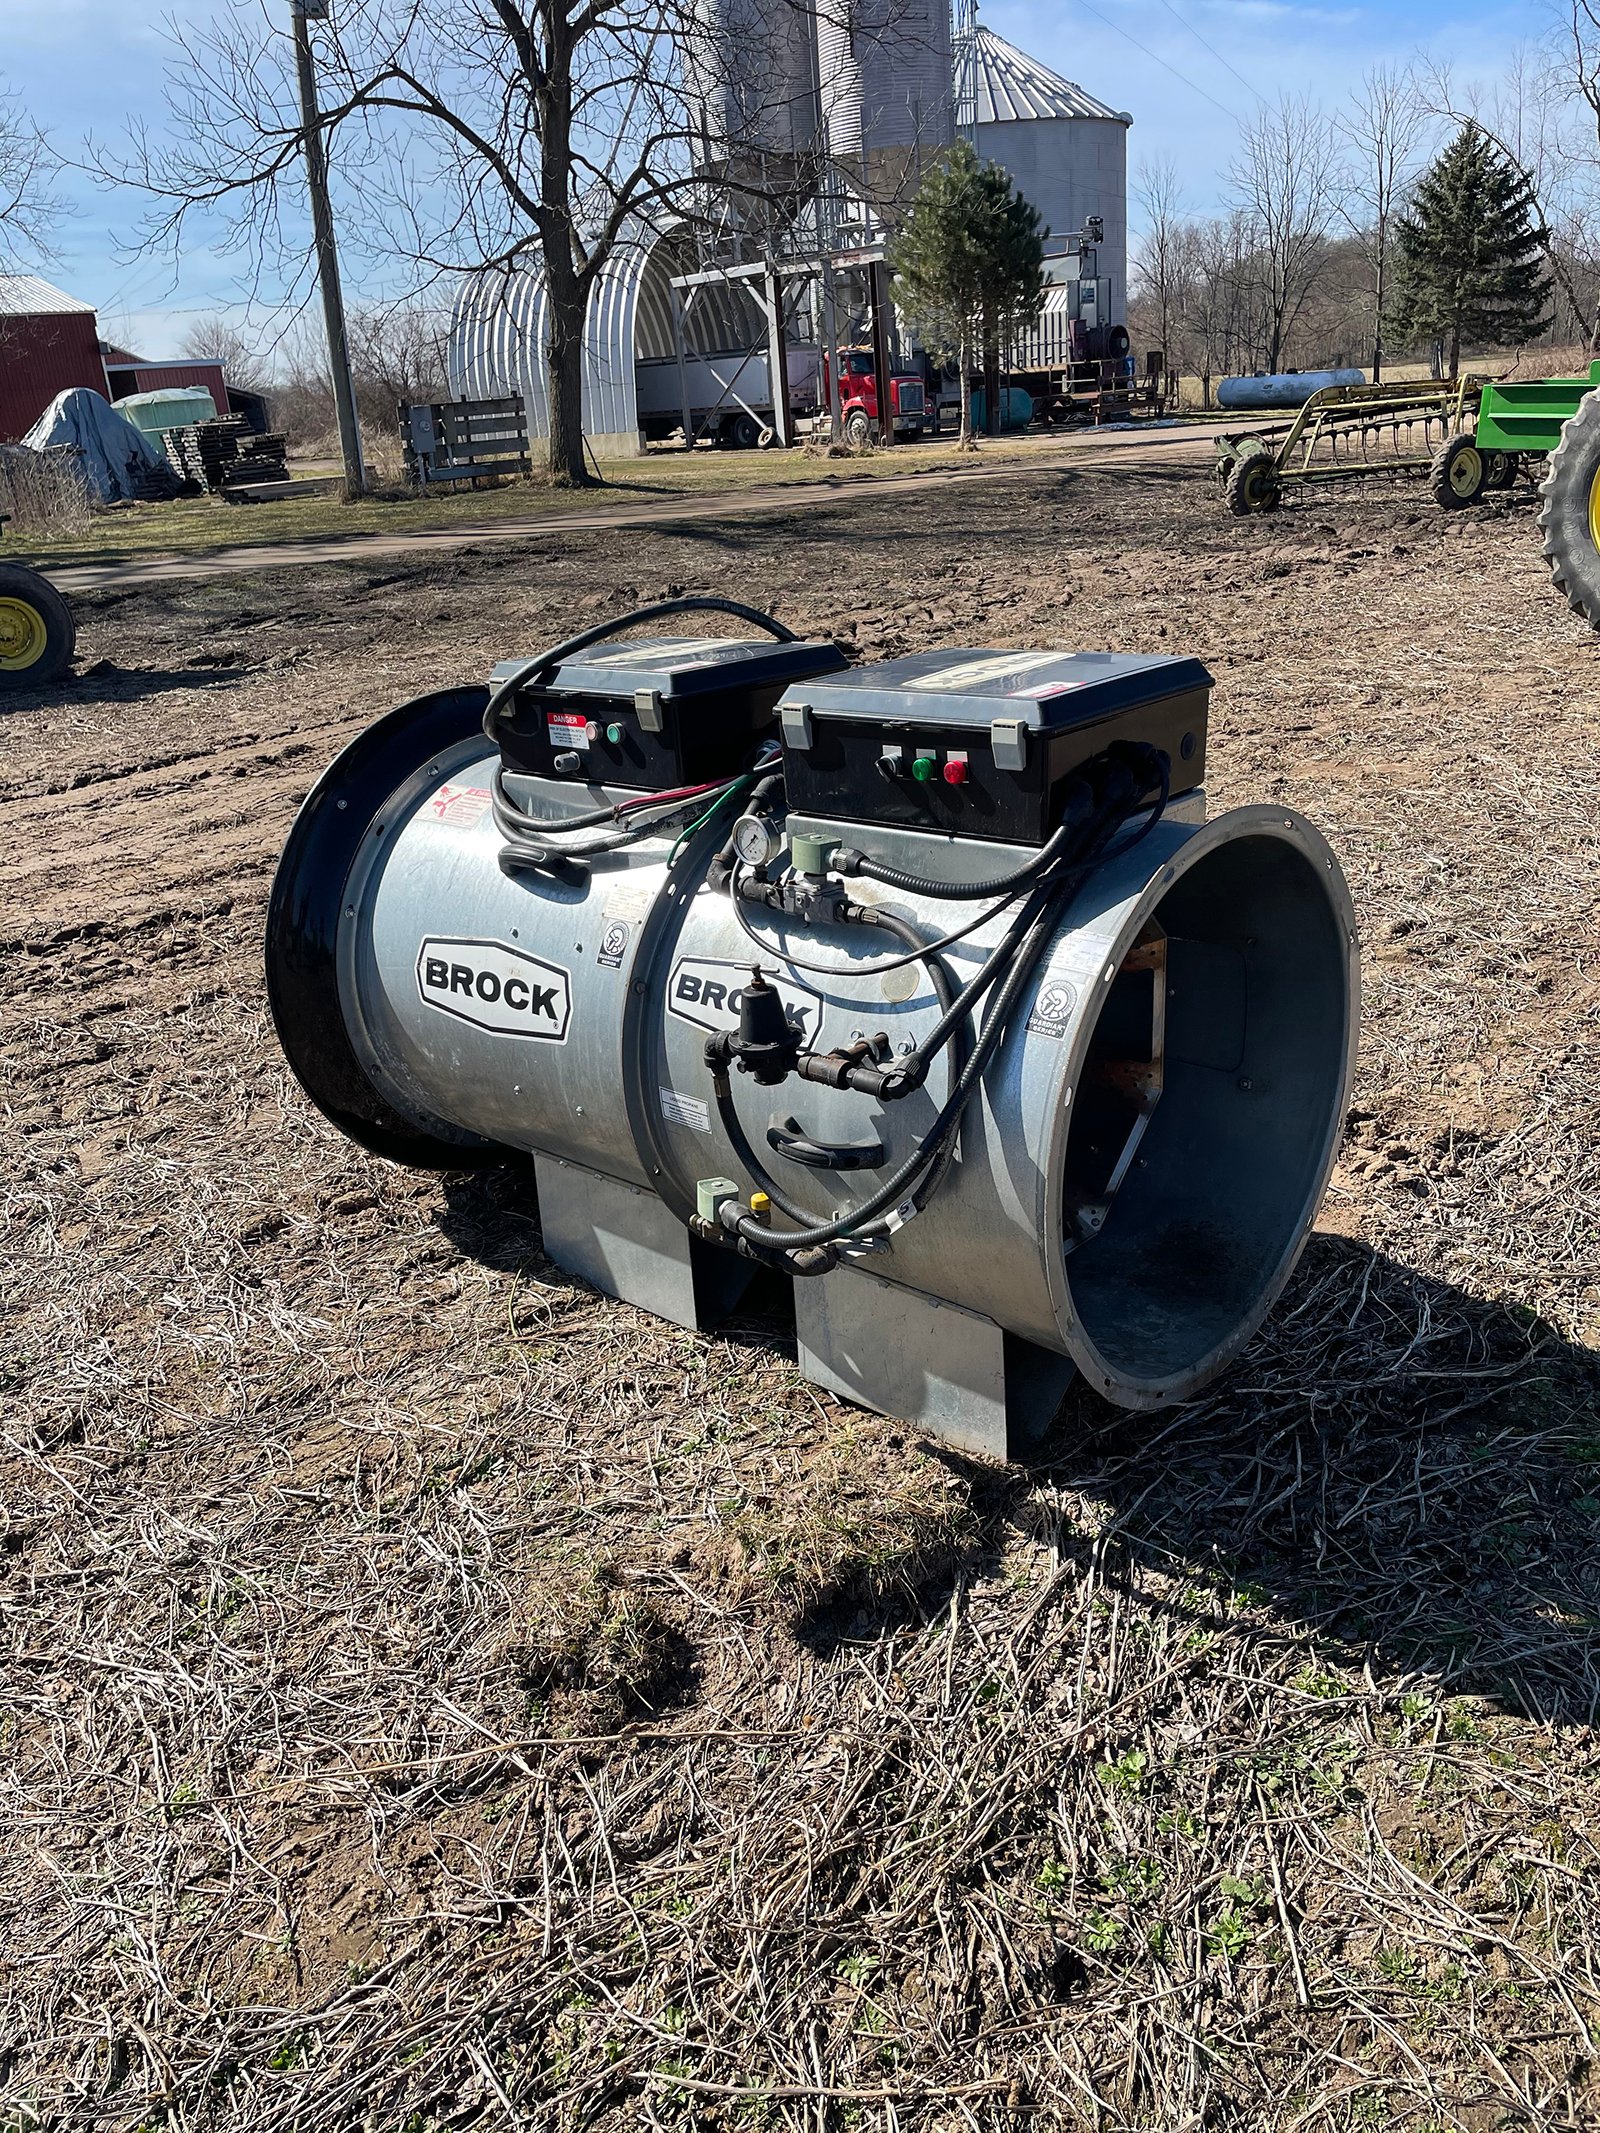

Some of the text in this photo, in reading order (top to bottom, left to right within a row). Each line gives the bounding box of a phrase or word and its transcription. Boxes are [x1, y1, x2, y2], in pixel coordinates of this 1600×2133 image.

[553, 714, 578, 725] DANGER
[426, 956, 560, 1021] BROCK
[676, 973, 813, 1035] BROK
